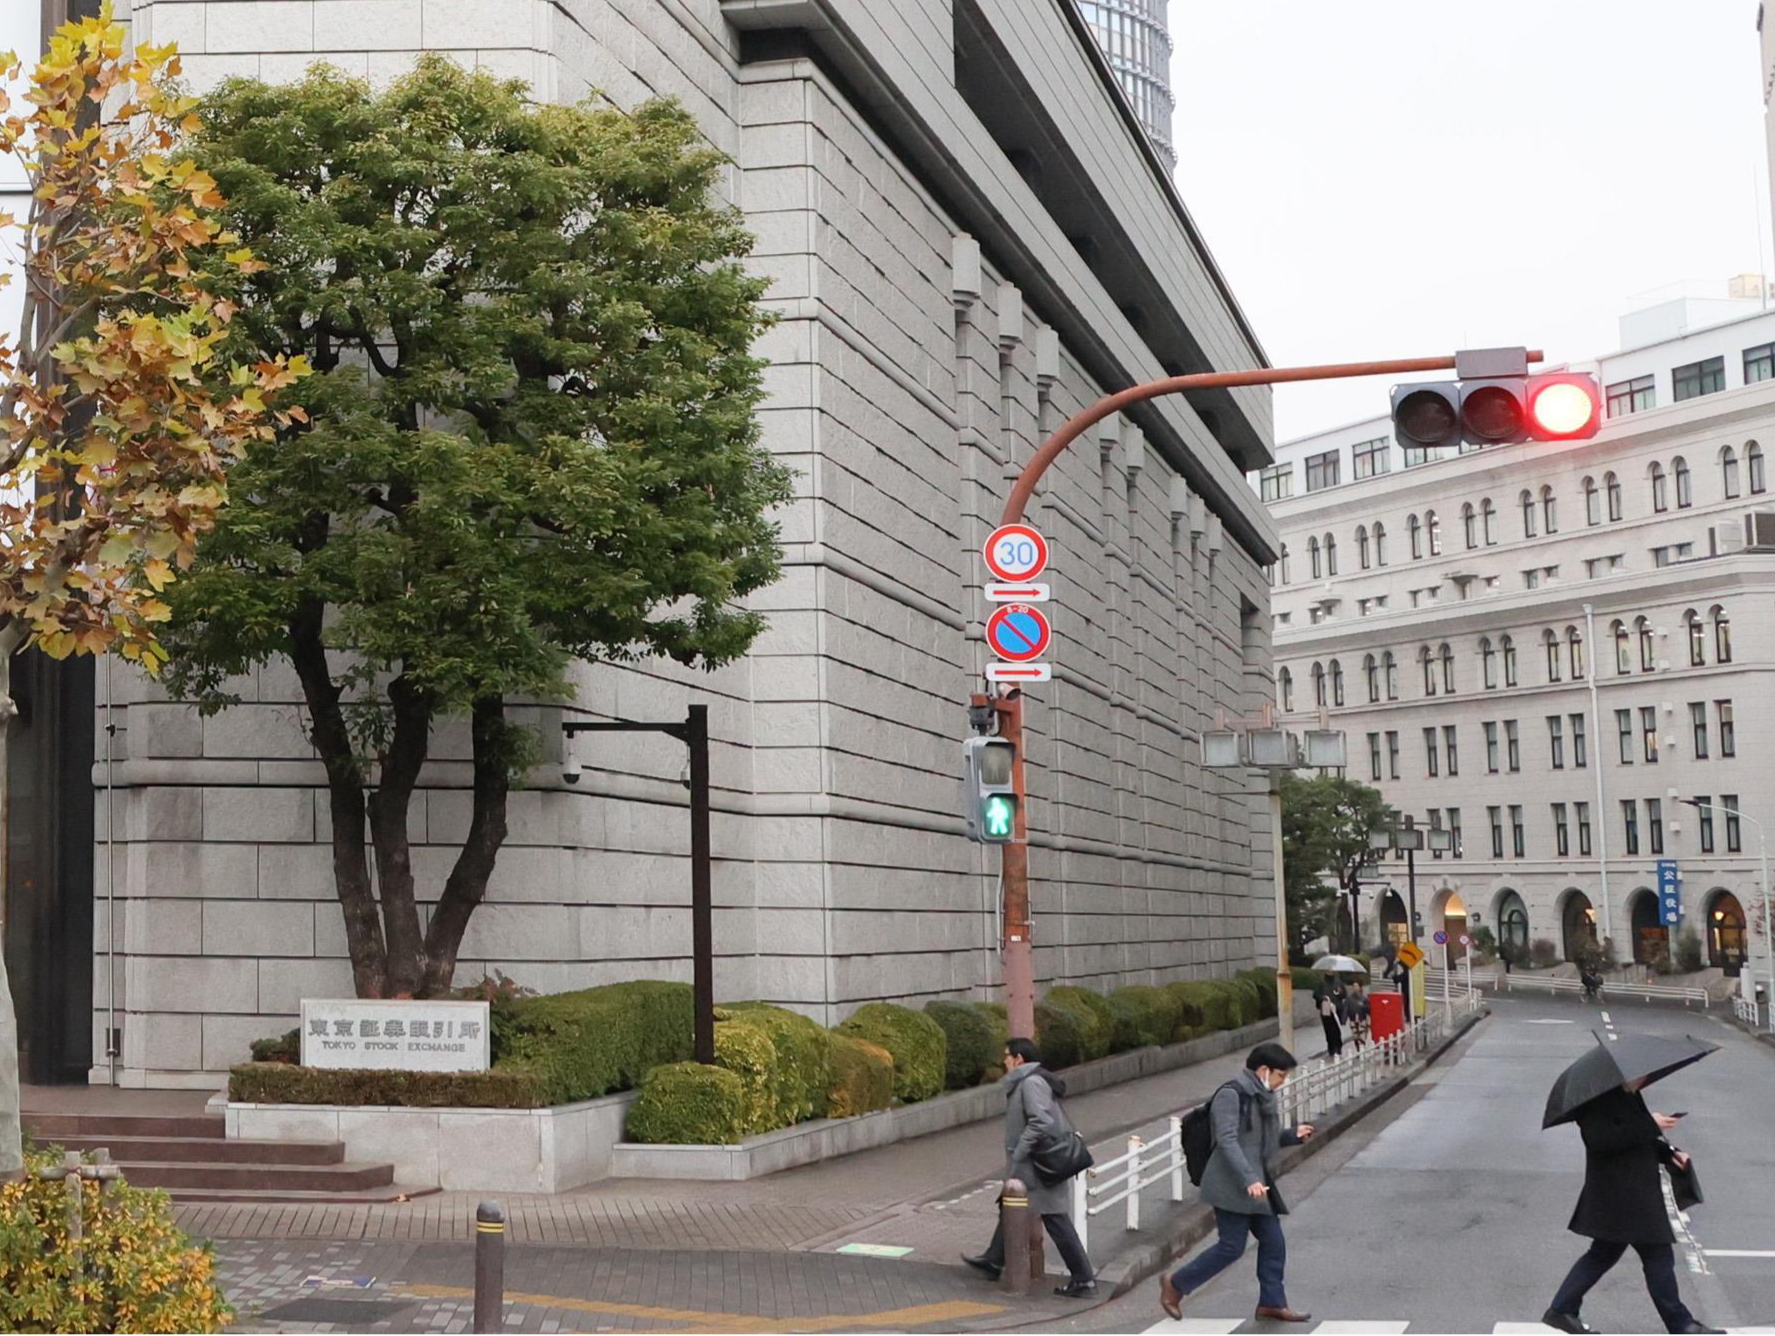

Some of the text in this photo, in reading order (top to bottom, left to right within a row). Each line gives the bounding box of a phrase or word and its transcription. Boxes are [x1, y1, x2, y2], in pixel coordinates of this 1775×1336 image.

[1000, 541, 1034, 566] 30
[1006, 605, 1029, 614] 8-20
[308, 1019, 481, 1040] 東京証券取引所
[321, 1040, 467, 1053] TOKYO STOCK EXCHANGE
